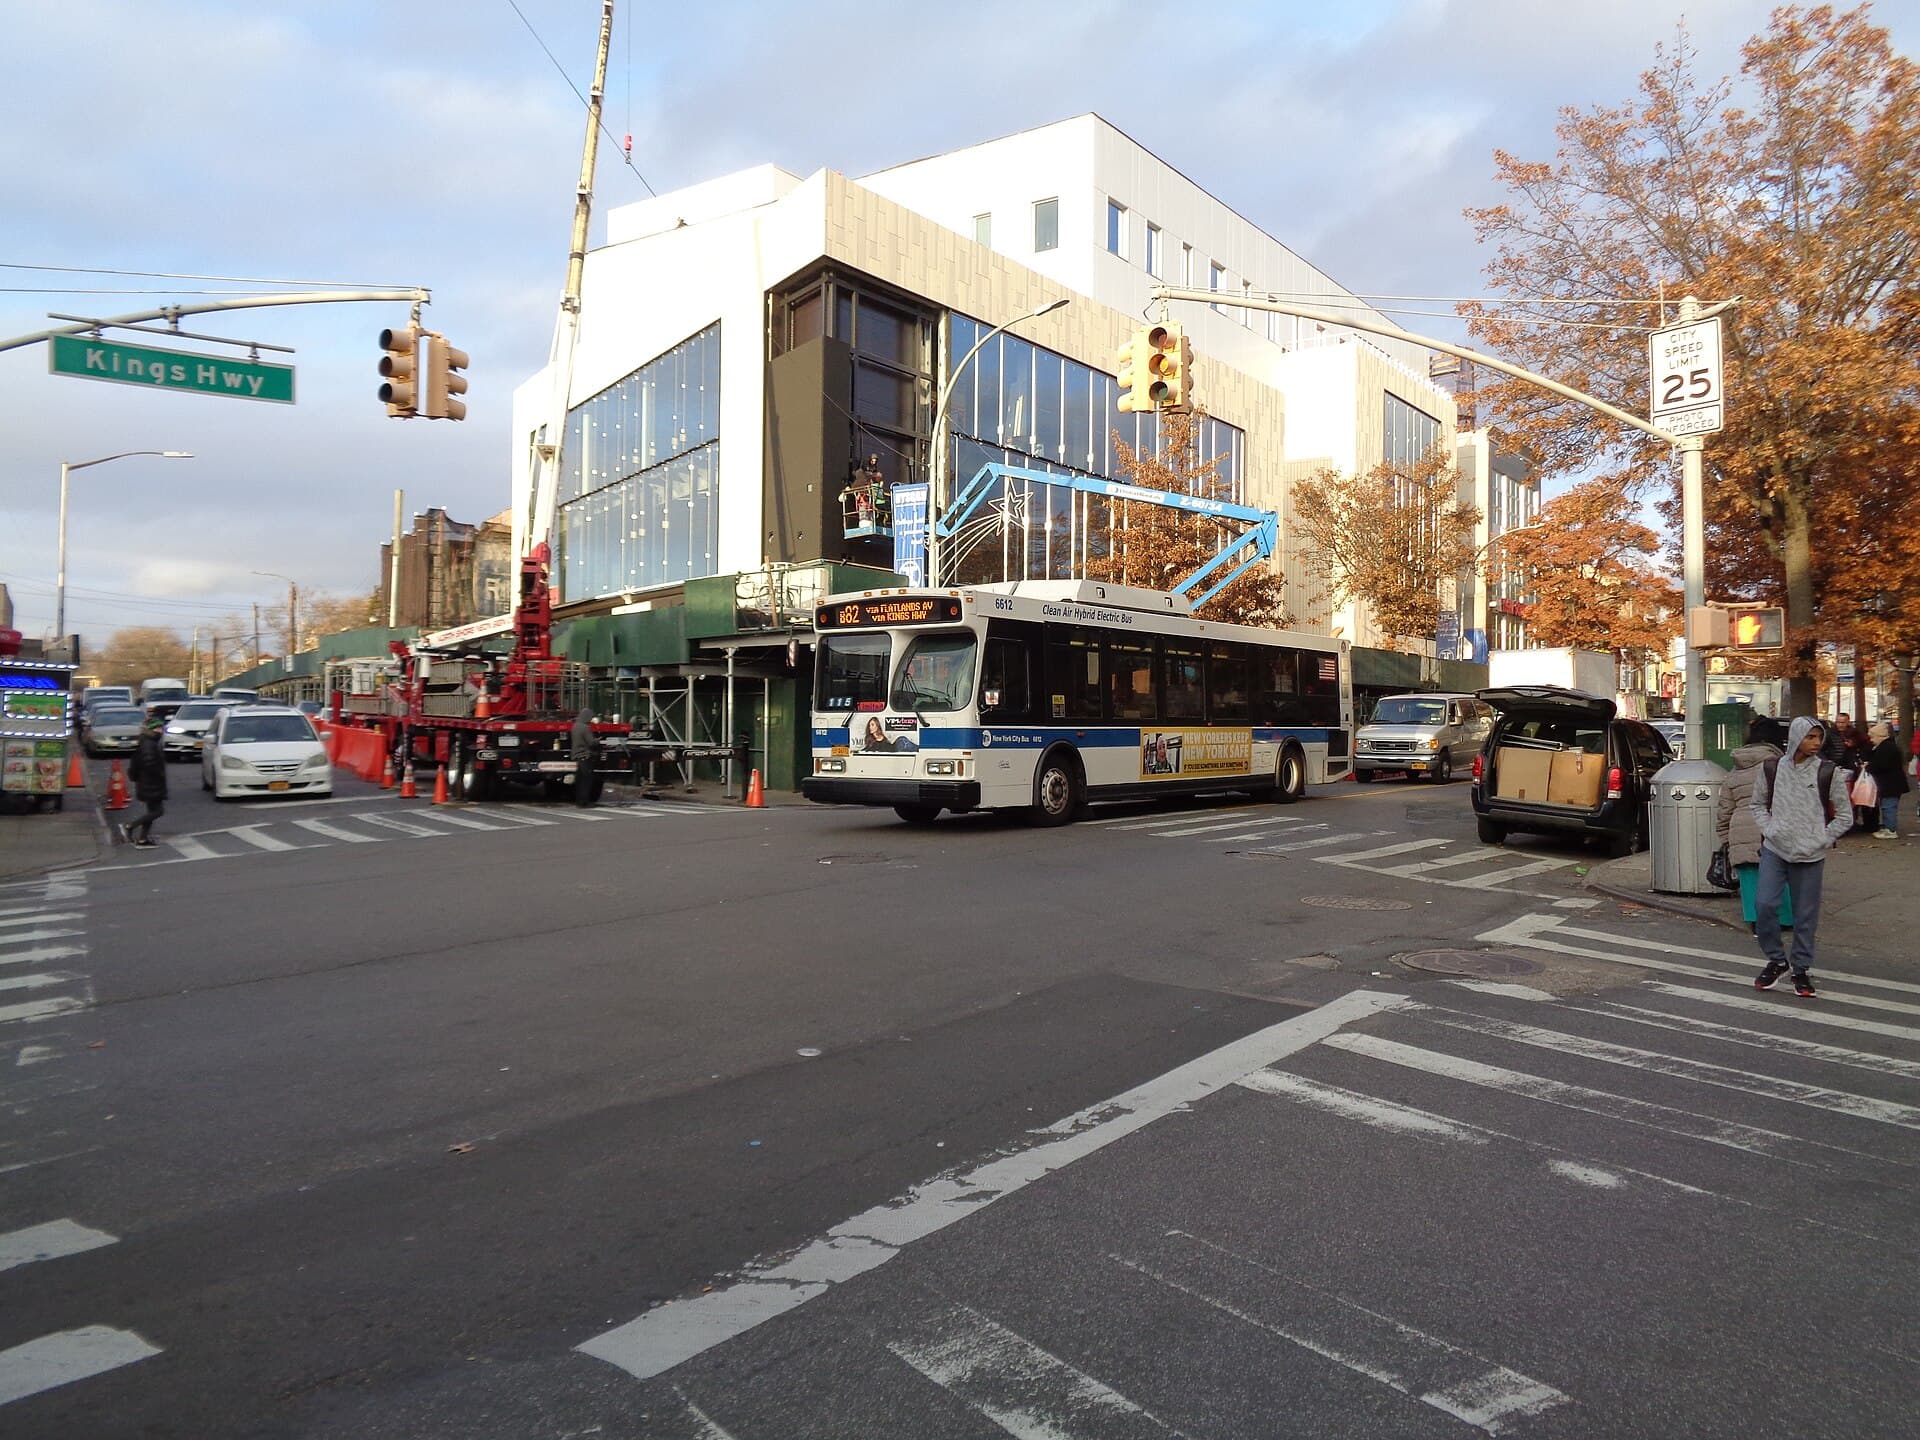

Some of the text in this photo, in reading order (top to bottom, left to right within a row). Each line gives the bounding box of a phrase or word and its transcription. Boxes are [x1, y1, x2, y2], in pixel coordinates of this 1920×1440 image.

[1670, 329, 1697, 343] CITY
[1664, 341, 1704, 358] SPEED
[1669, 355, 1700, 370] LIMIT
[85, 347, 265, 396] Kings Hwy
[1662, 368, 1712, 405] 25
[1669, 411, 1705, 424] PHOTO
[1660, 418, 1715, 434] NFORCED
[880, 602, 920, 613] FLATLANDS
[922, 601, 934, 611] AV
[995, 598, 1013, 611] 6612
[839, 604, 860, 624] B82
[887, 611, 910, 622] KINGS
[911, 610, 927, 620] HWY
[1042, 604, 1133, 625] Clean Air Hybrid Electric Bus
[828, 697, 852, 707] 115
[1012, 735, 1021, 743] City
[1184, 732, 1249, 745] NEW YORKERS KEEP
[1184, 744, 1249, 760] NEW YORK SAFE
